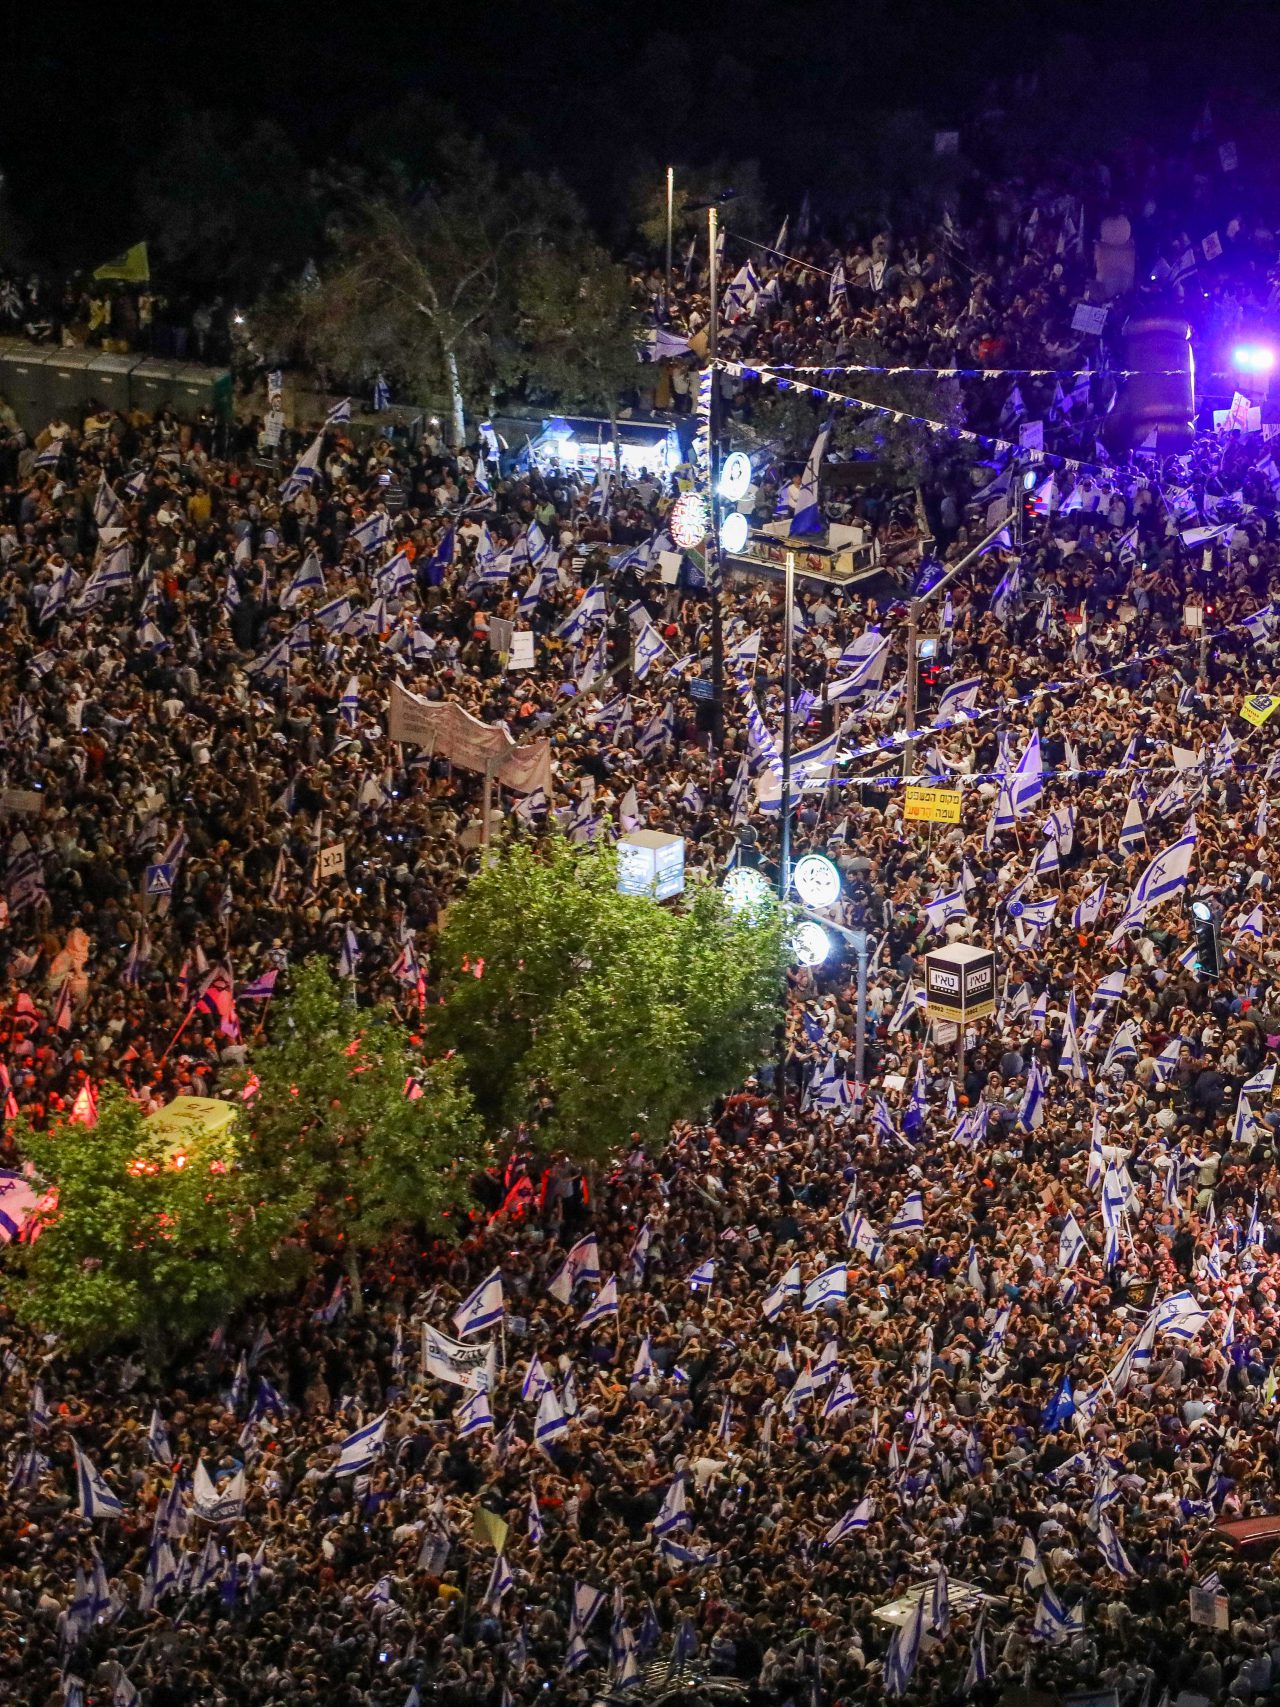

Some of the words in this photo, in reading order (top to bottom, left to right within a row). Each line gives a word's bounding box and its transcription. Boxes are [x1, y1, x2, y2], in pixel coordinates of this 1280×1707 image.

[906, 790, 936, 802] המשפט
[940, 794, 959, 805] מקום
[935, 808, 955, 818] שמה
